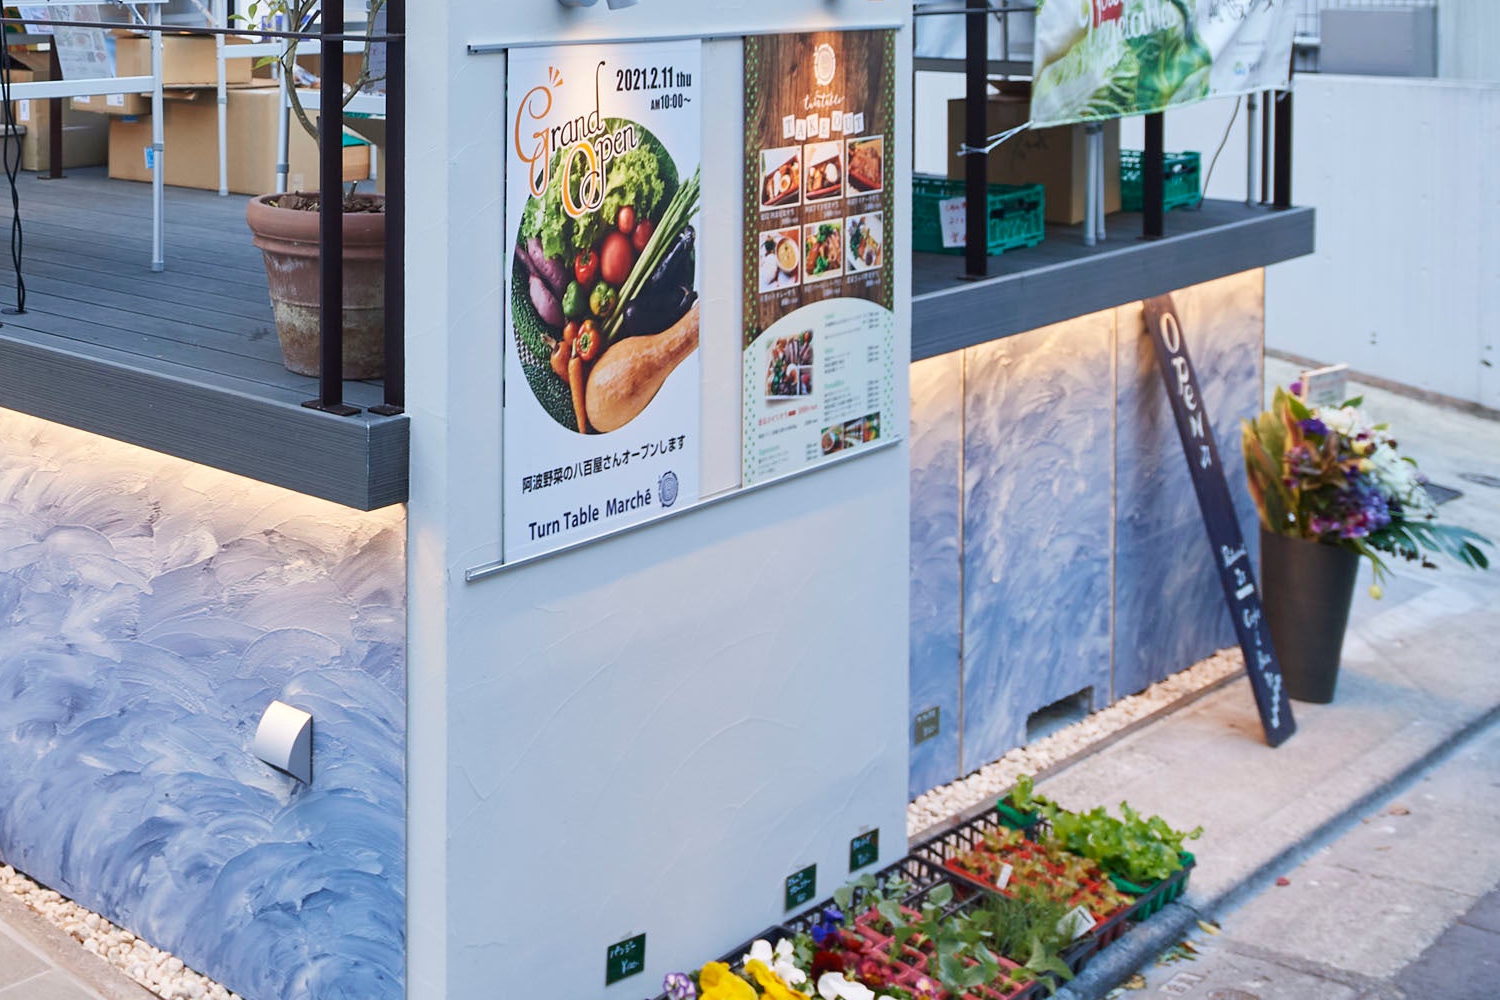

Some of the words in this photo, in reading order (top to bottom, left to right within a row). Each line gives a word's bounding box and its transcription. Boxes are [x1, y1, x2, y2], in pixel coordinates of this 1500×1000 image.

[616, 66, 674, 92] 2021.2.11
[676, 71, 692, 88] thu
[514, 60, 606, 197] Grand
[784, 115, 831, 139] TAKE
[833, 112, 863, 134] OUT
[562, 125, 638, 217] Open
[522, 434, 687, 494] 阿波野菜の八百屋さんオープンします
[528, 516, 560, 541] Turn
[563, 504, 600, 530] Table
[606, 487, 651, 517] Marché
